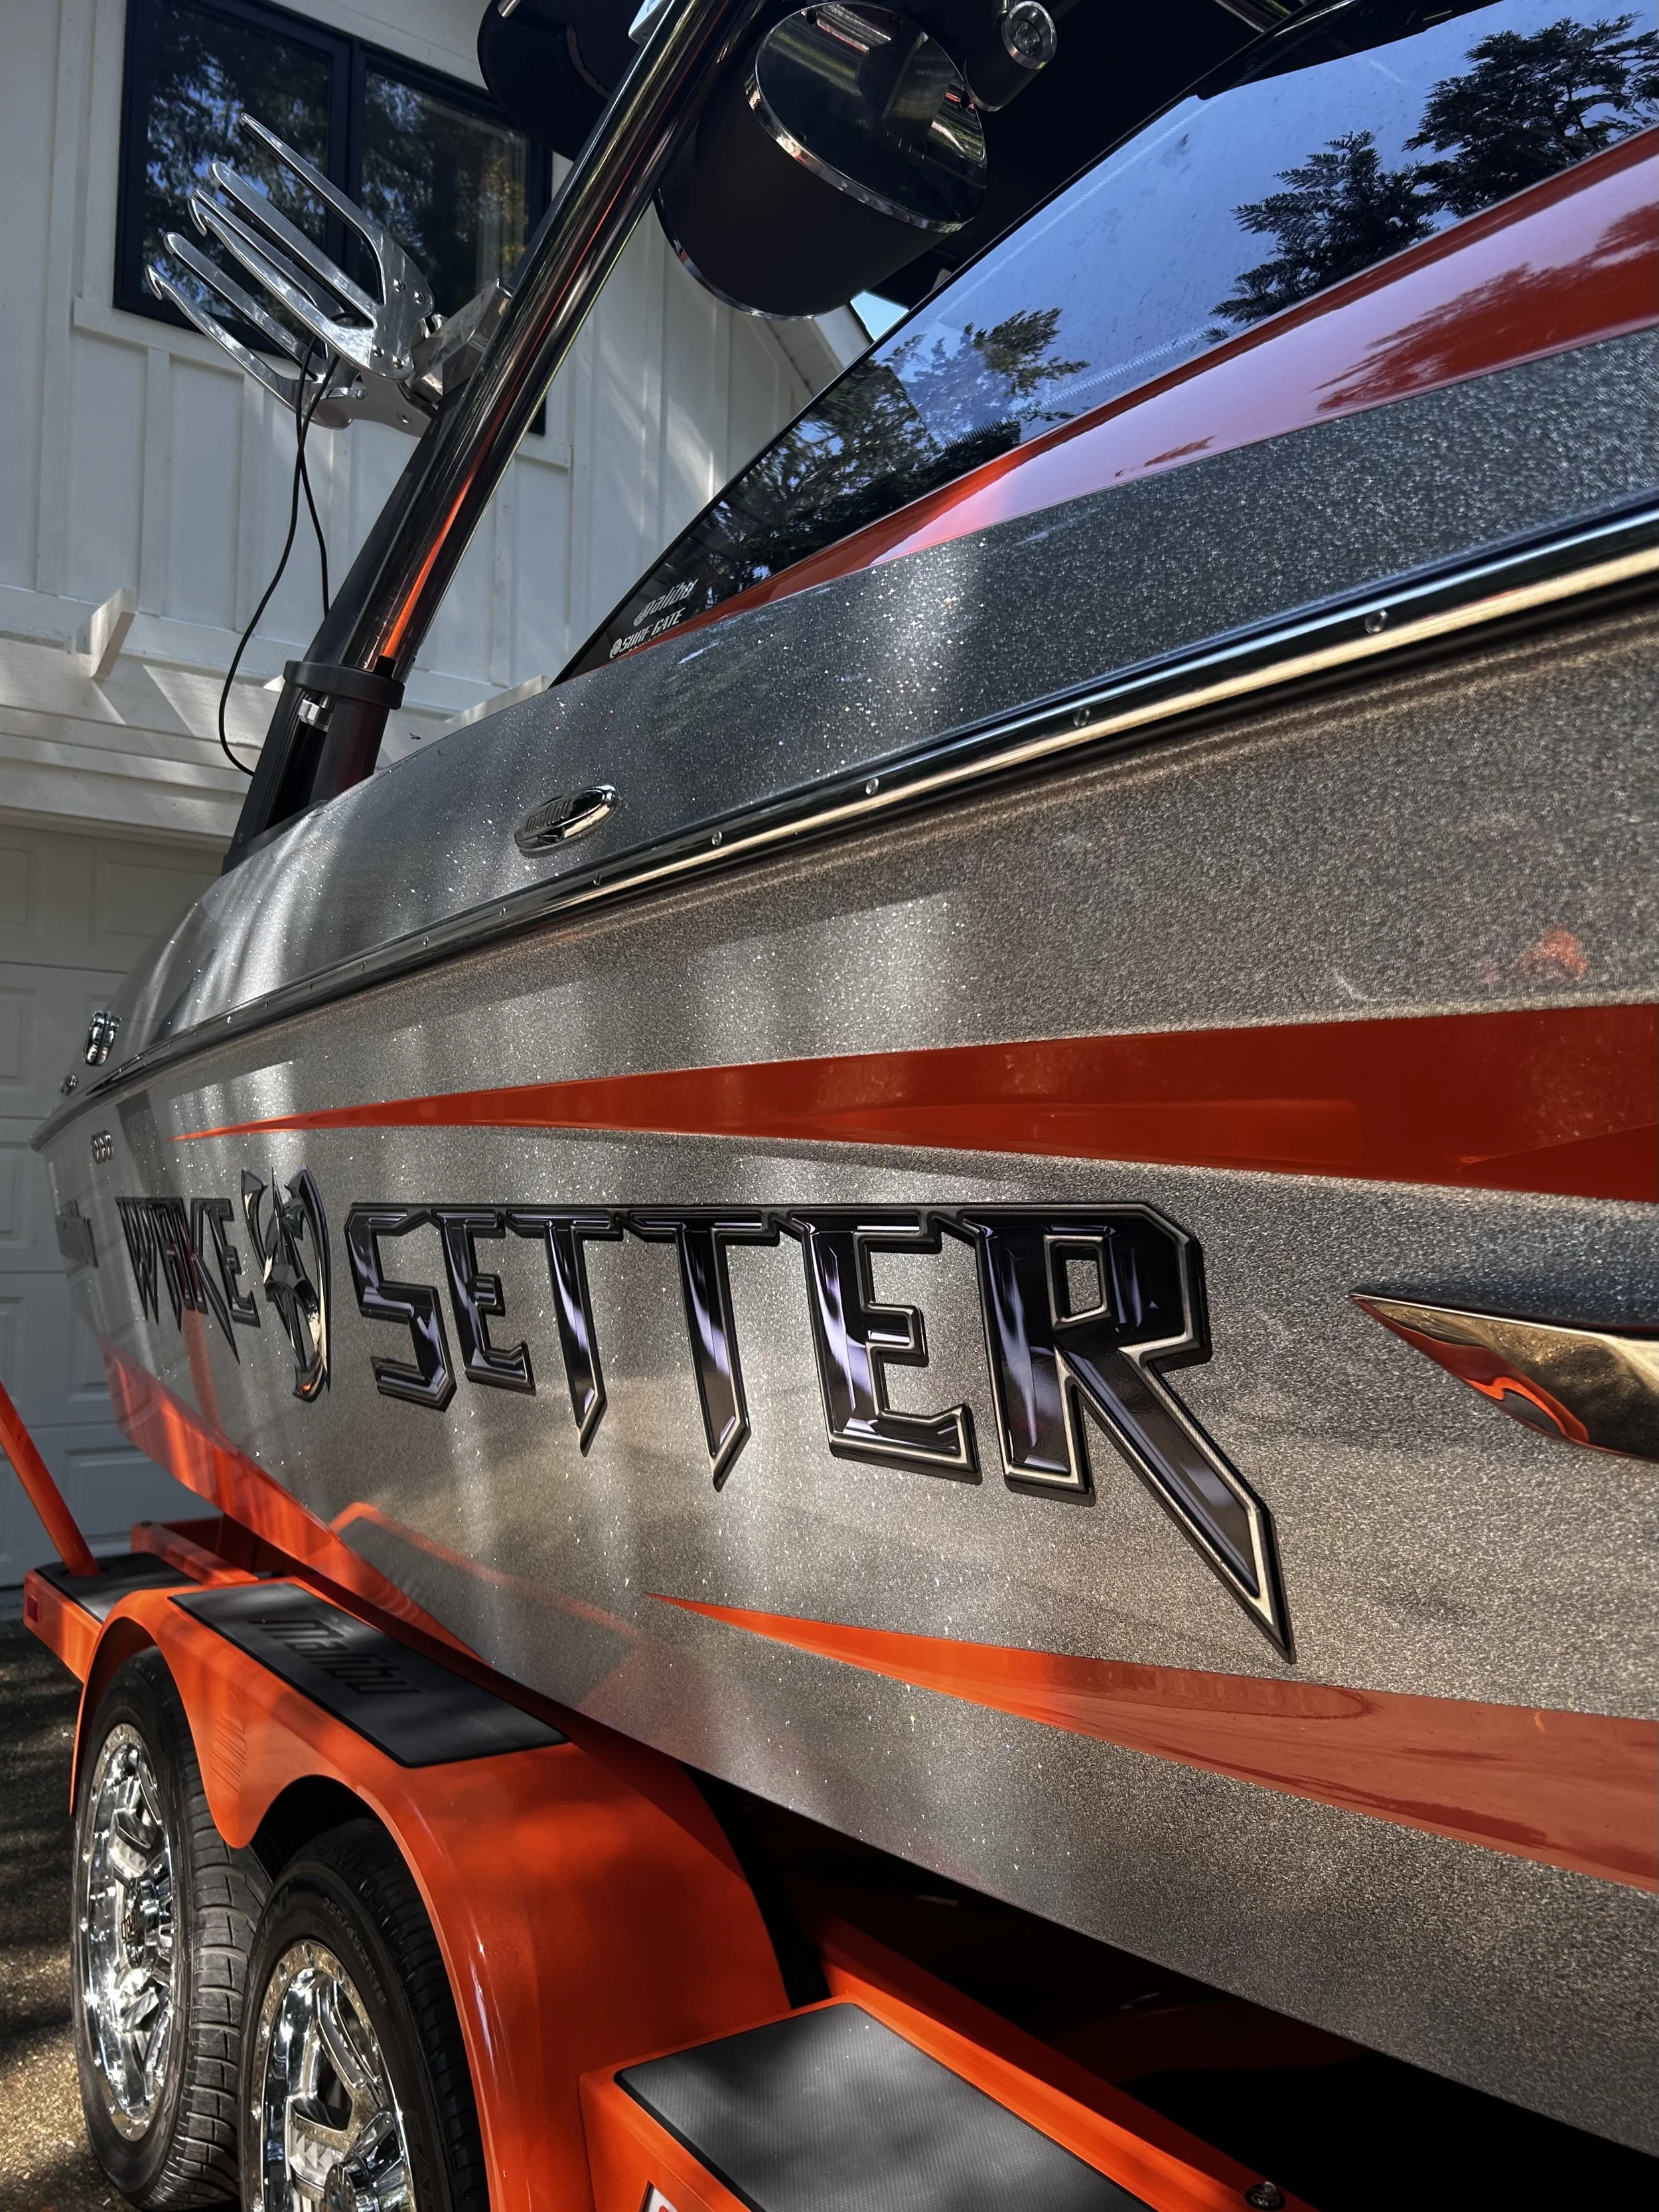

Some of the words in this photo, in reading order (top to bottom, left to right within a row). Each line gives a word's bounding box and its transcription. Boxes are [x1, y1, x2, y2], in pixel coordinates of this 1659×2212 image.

[619, 623, 654, 653] SURF
[650, 607, 686, 636] GATE
[115, 1197, 261, 1365] WAKE
[344, 1202, 1296, 1664] SETTER
